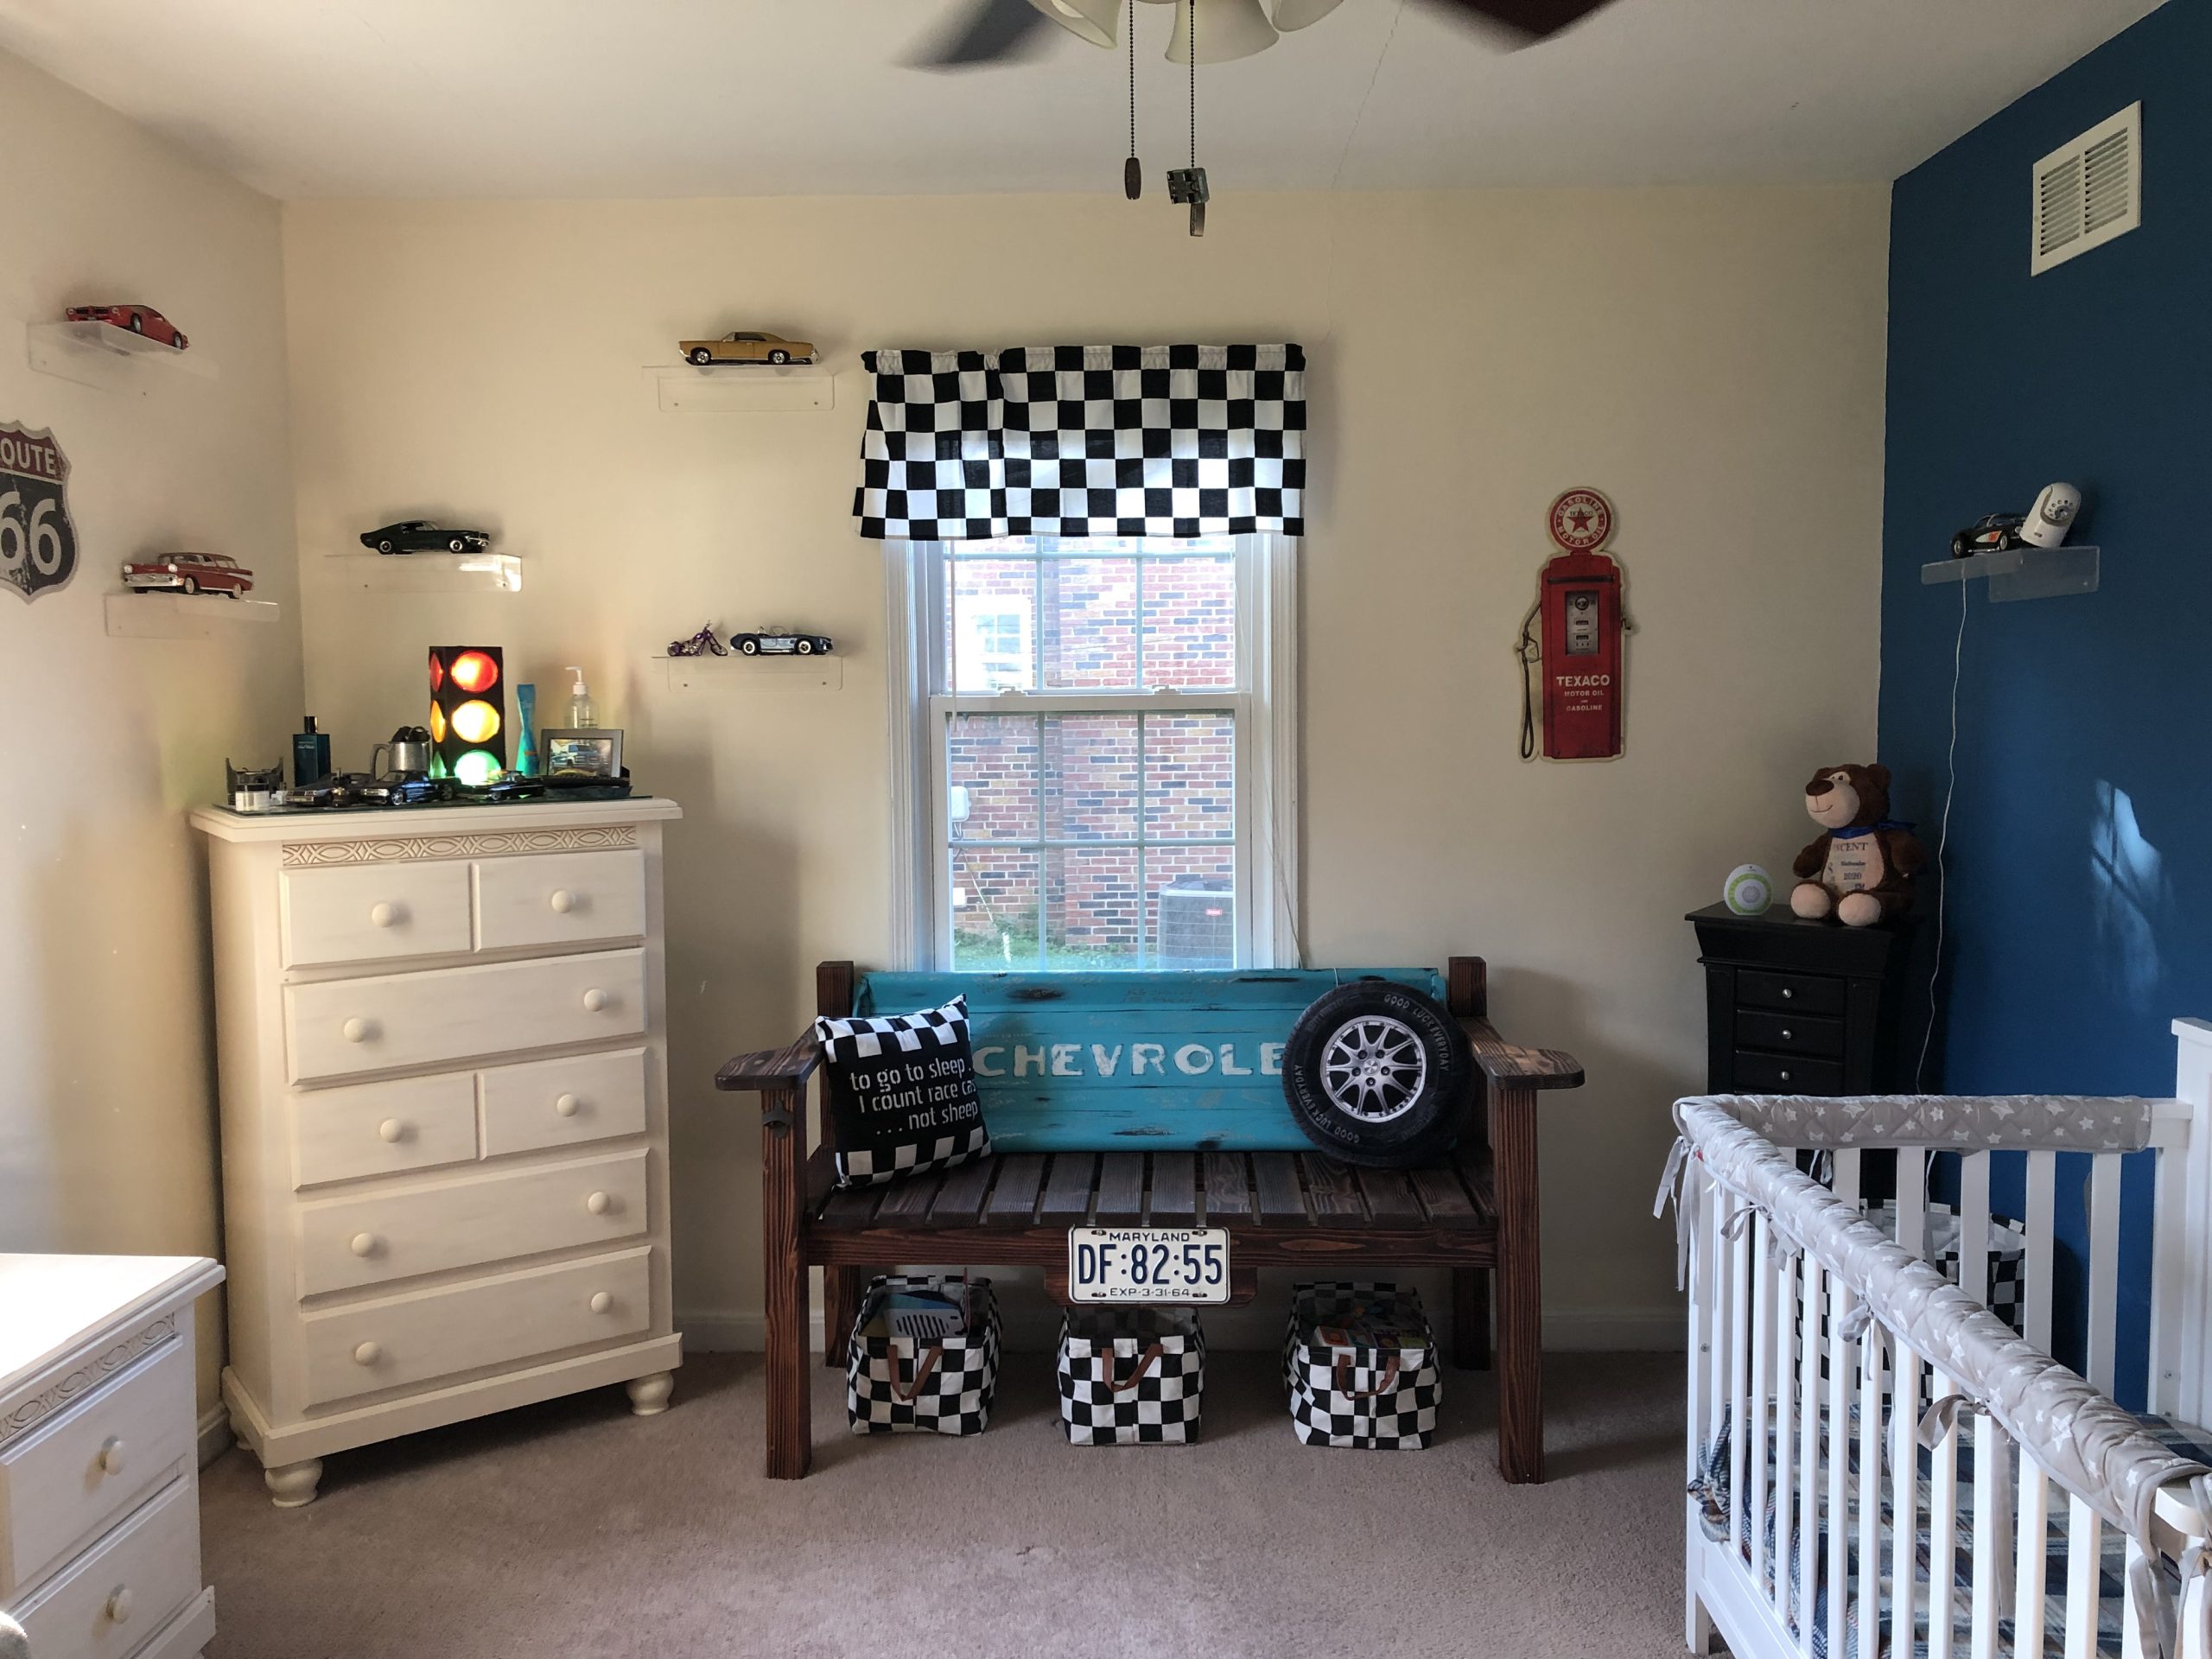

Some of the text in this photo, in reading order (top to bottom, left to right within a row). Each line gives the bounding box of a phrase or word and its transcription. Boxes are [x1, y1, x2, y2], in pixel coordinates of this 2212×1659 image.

[0, 437, 56, 474] OUTE
[0, 491, 61, 575] 66
[1558, 525, 1590, 545] MOTOR
[1556, 674, 1611, 687] TEXACO
[1383, 994, 1451, 1072] GOOD LUCK EVERYDAY
[972, 1042, 1285, 1077] CHEVROLE
[849, 1071, 871, 1091] to
[876, 1068, 901, 1093] go
[905, 1063, 925, 1083] to
[858, 1095, 866, 1114] I
[872, 1086, 924, 1112] count
[928, 1082, 958, 1103] race
[1294, 1064, 1360, 1144] GOOD LUCK EVERYDAY
[908, 1107, 938, 1131] not
[941, 1100, 979, 1125] sheep
[1109, 1232, 1190, 1243] MARYLAND
